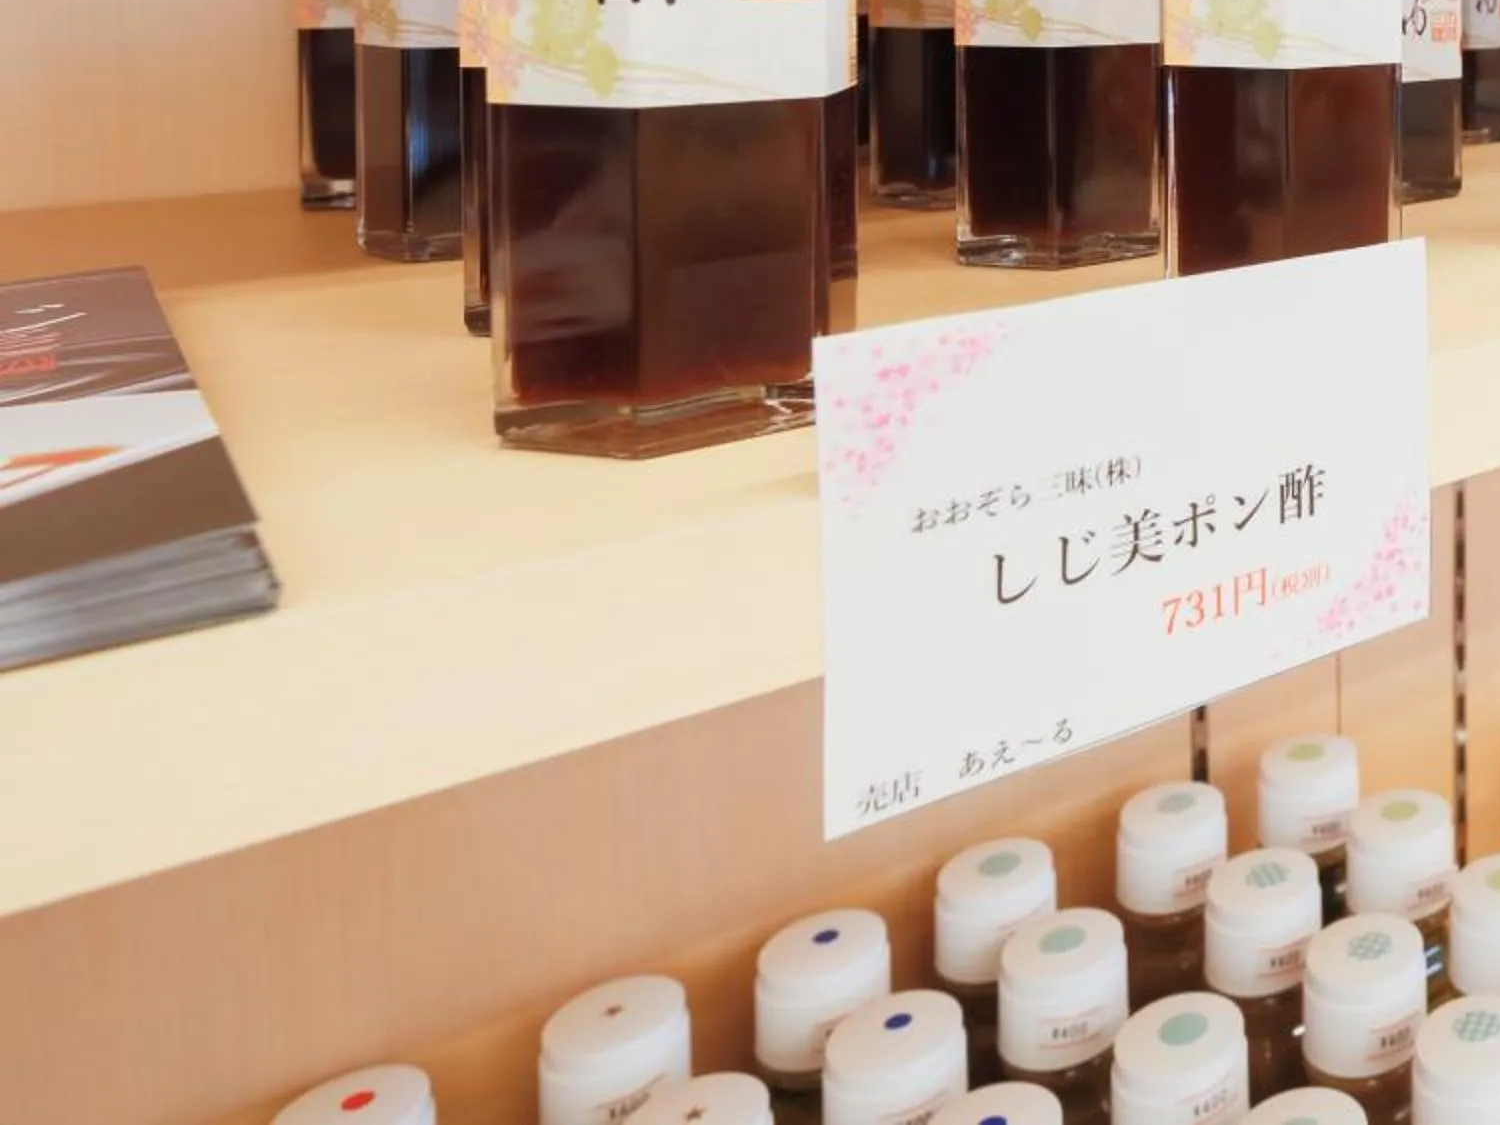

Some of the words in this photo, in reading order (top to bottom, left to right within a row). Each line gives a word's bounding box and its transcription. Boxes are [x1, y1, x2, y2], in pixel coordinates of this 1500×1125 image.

[992, 463, 1327, 606] しじ美ポン酢
[854, 769, 923, 818] 売店
